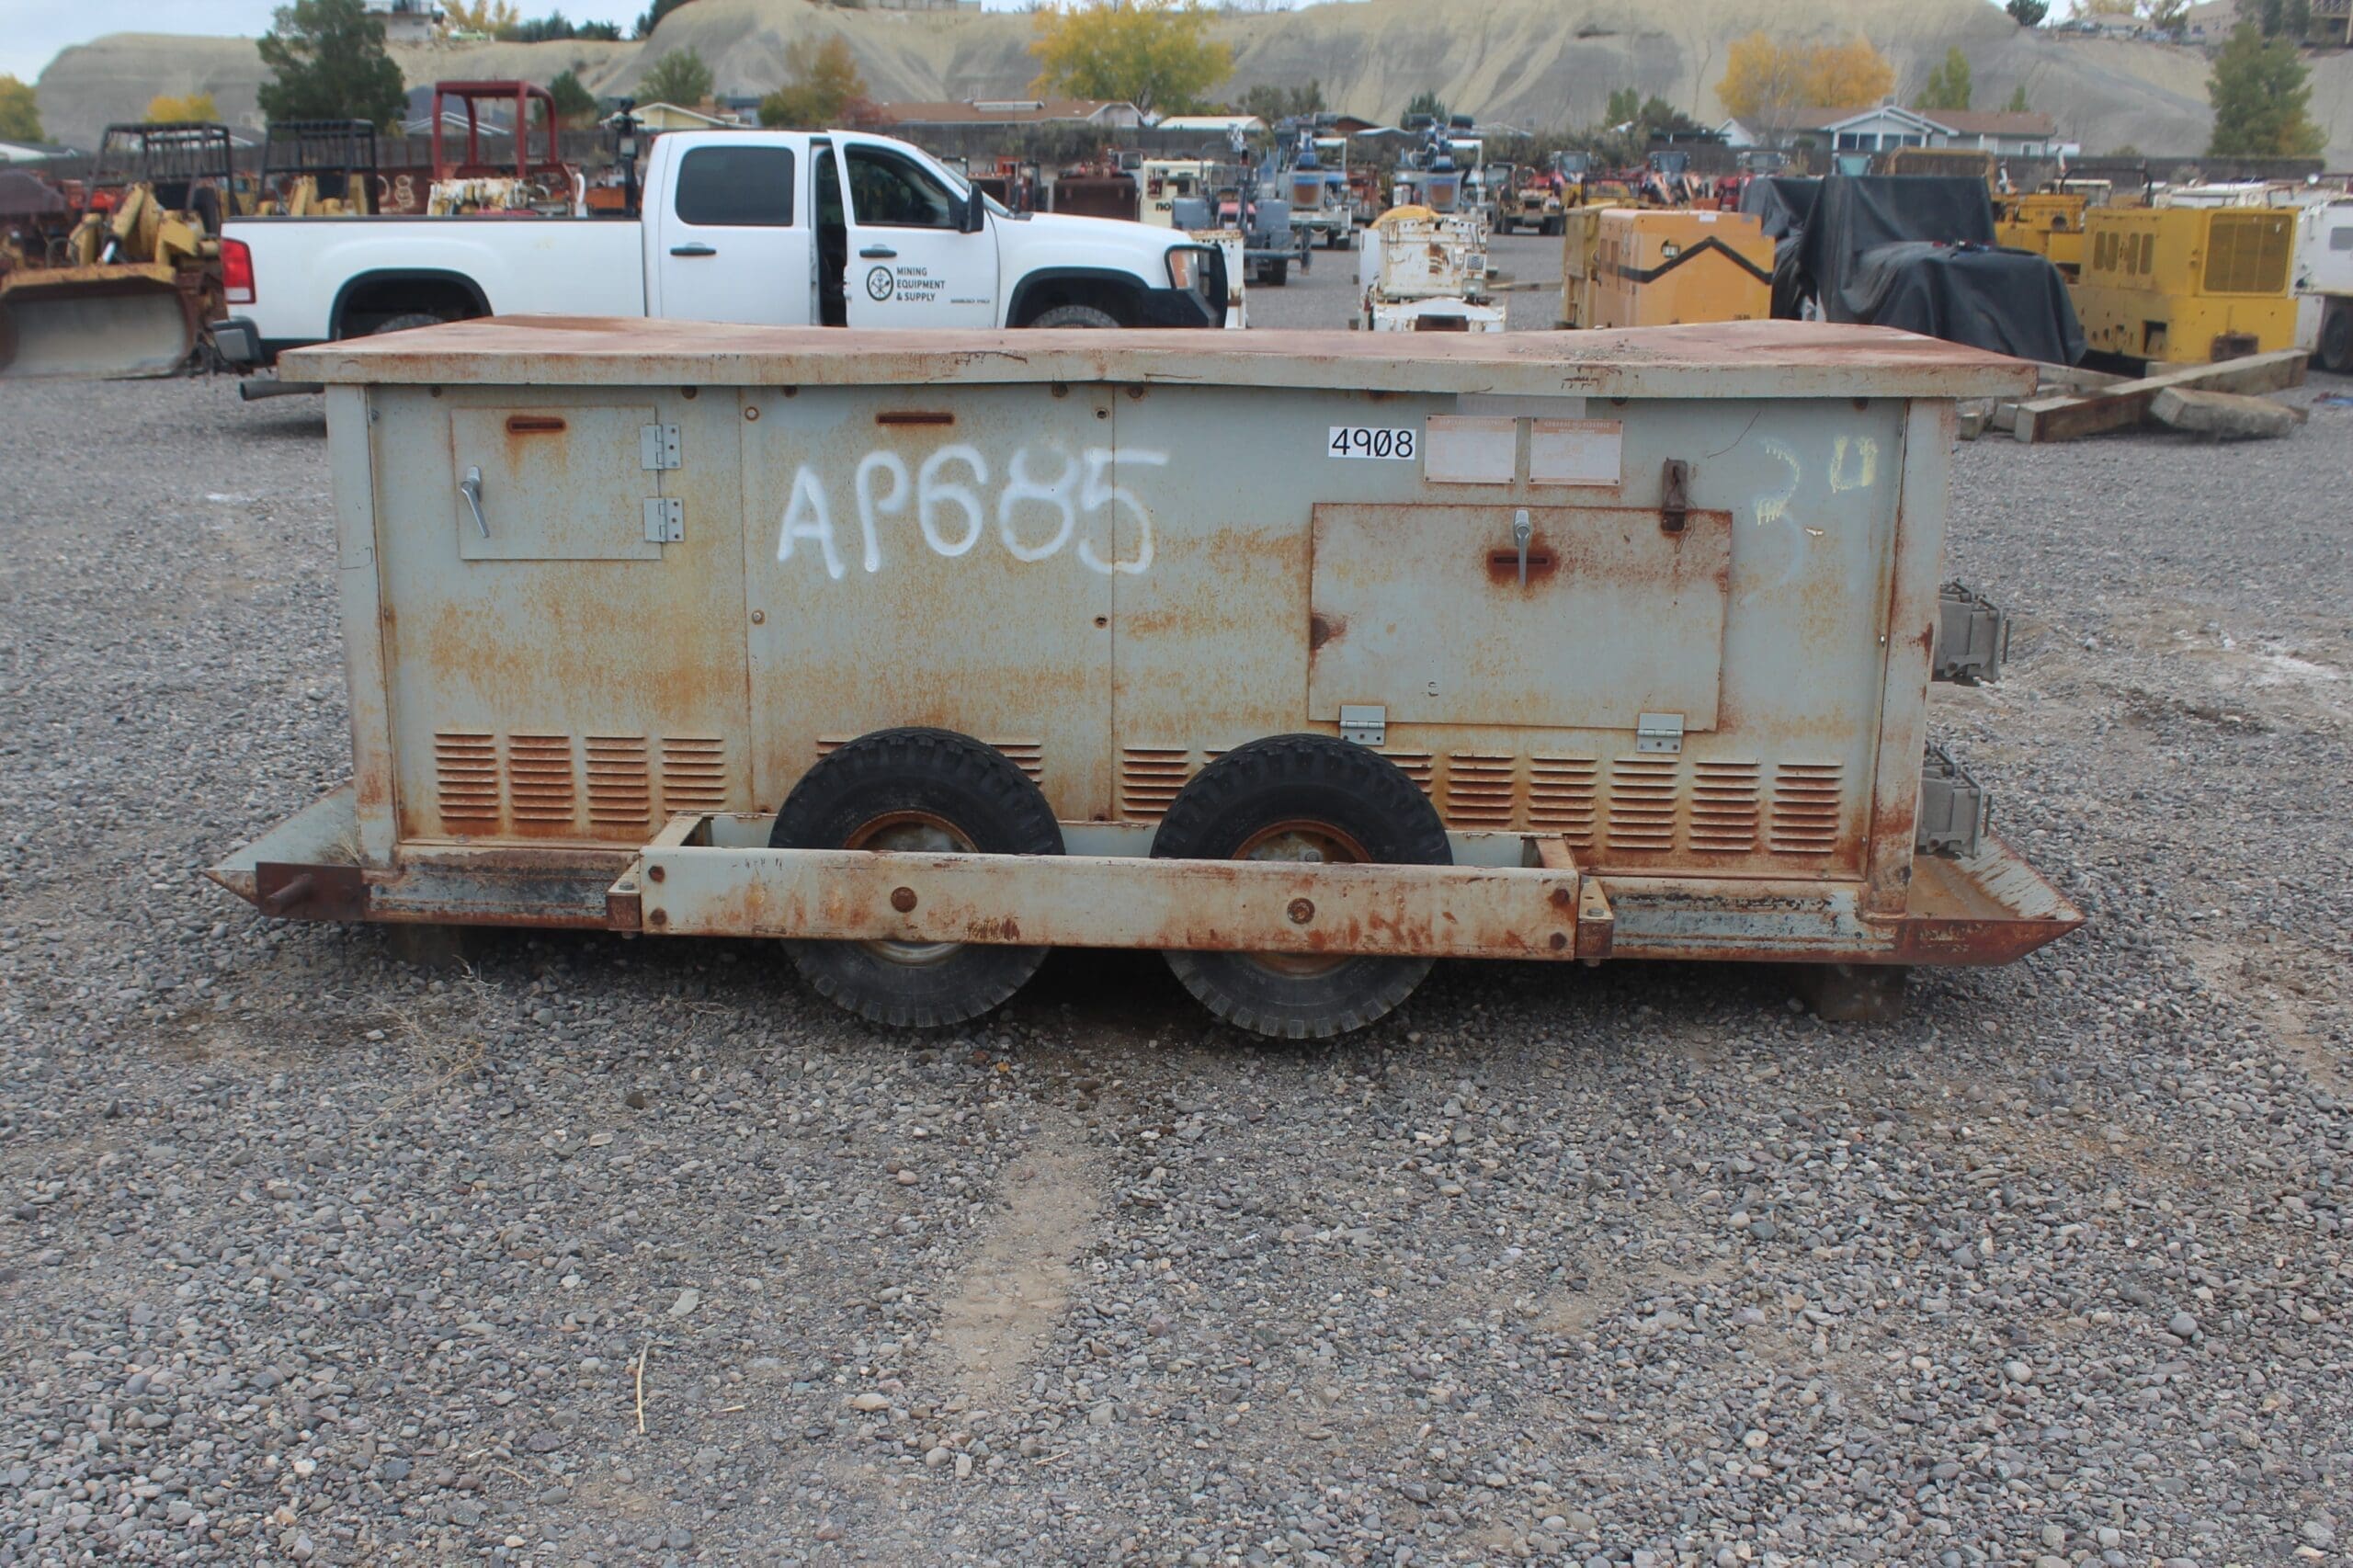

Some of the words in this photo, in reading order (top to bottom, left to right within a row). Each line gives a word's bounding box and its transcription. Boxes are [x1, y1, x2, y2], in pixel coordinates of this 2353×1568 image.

[896, 267, 927, 276] MINING
[896, 278, 946, 290] EQUIPMENT
[896, 291, 903, 301] &
[904, 291, 936, 302] SUPPLY
[1331, 427, 1414, 458] 4908
[777, 444, 1169, 579] AP685
